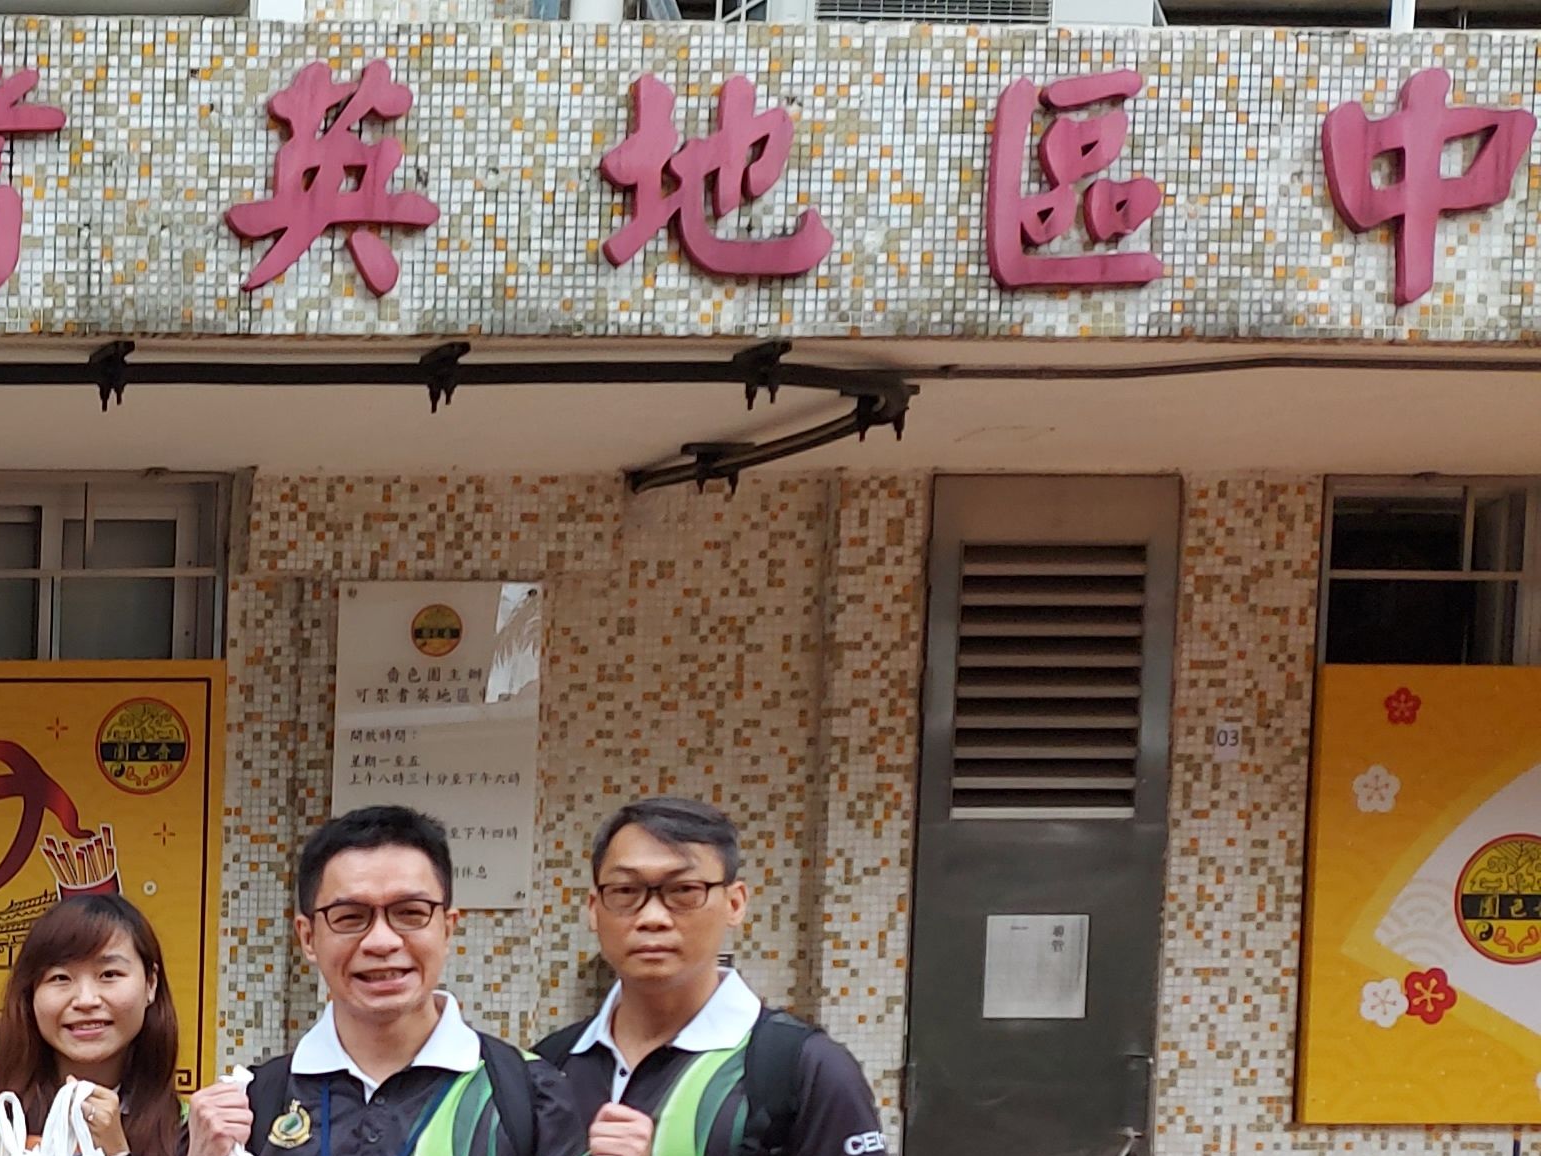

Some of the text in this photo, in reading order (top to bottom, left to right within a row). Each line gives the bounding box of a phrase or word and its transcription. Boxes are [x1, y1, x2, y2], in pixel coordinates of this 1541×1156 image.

[1216, 729, 1240, 747] 03
[350, 755, 421, 768] 星期一至五
[349, 771, 521, 787] 上午八時三十分至下午六時
